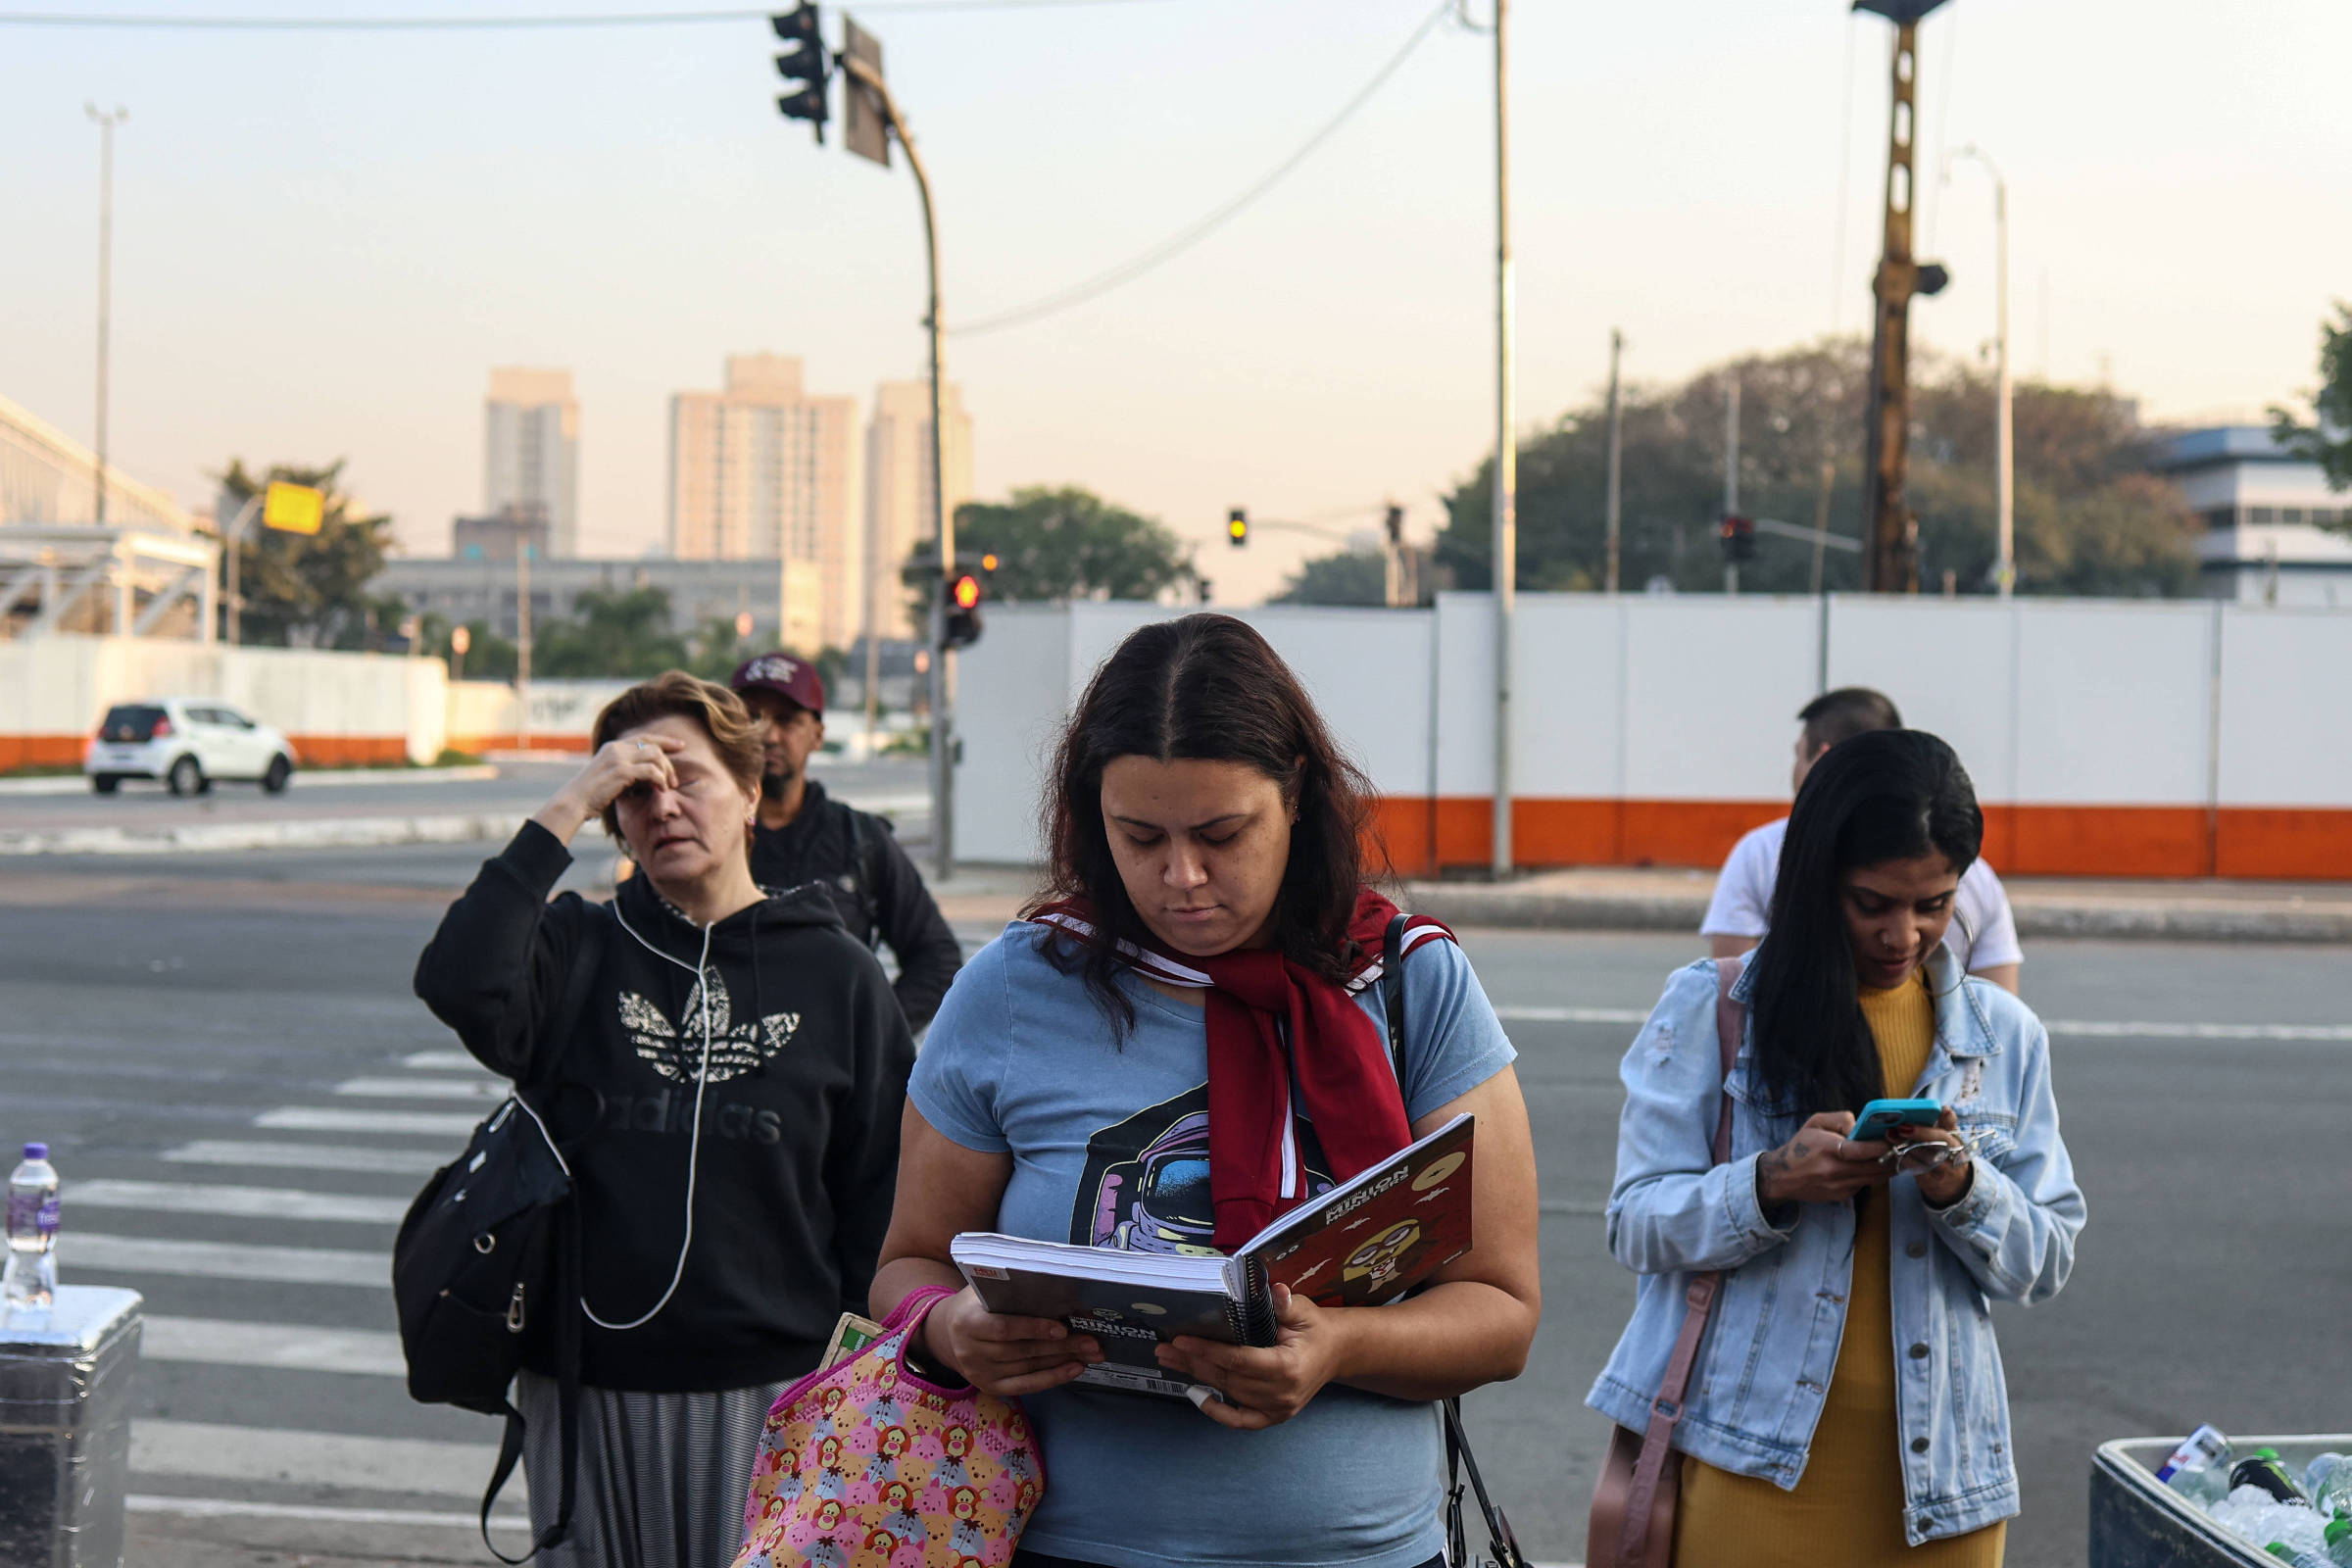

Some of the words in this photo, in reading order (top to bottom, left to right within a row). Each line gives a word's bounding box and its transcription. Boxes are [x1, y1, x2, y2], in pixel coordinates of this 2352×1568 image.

[607, 1088, 781, 1145] adidas
[1326, 1164, 1409, 1220] MINION
[1069, 1318, 1157, 1337] MINION
